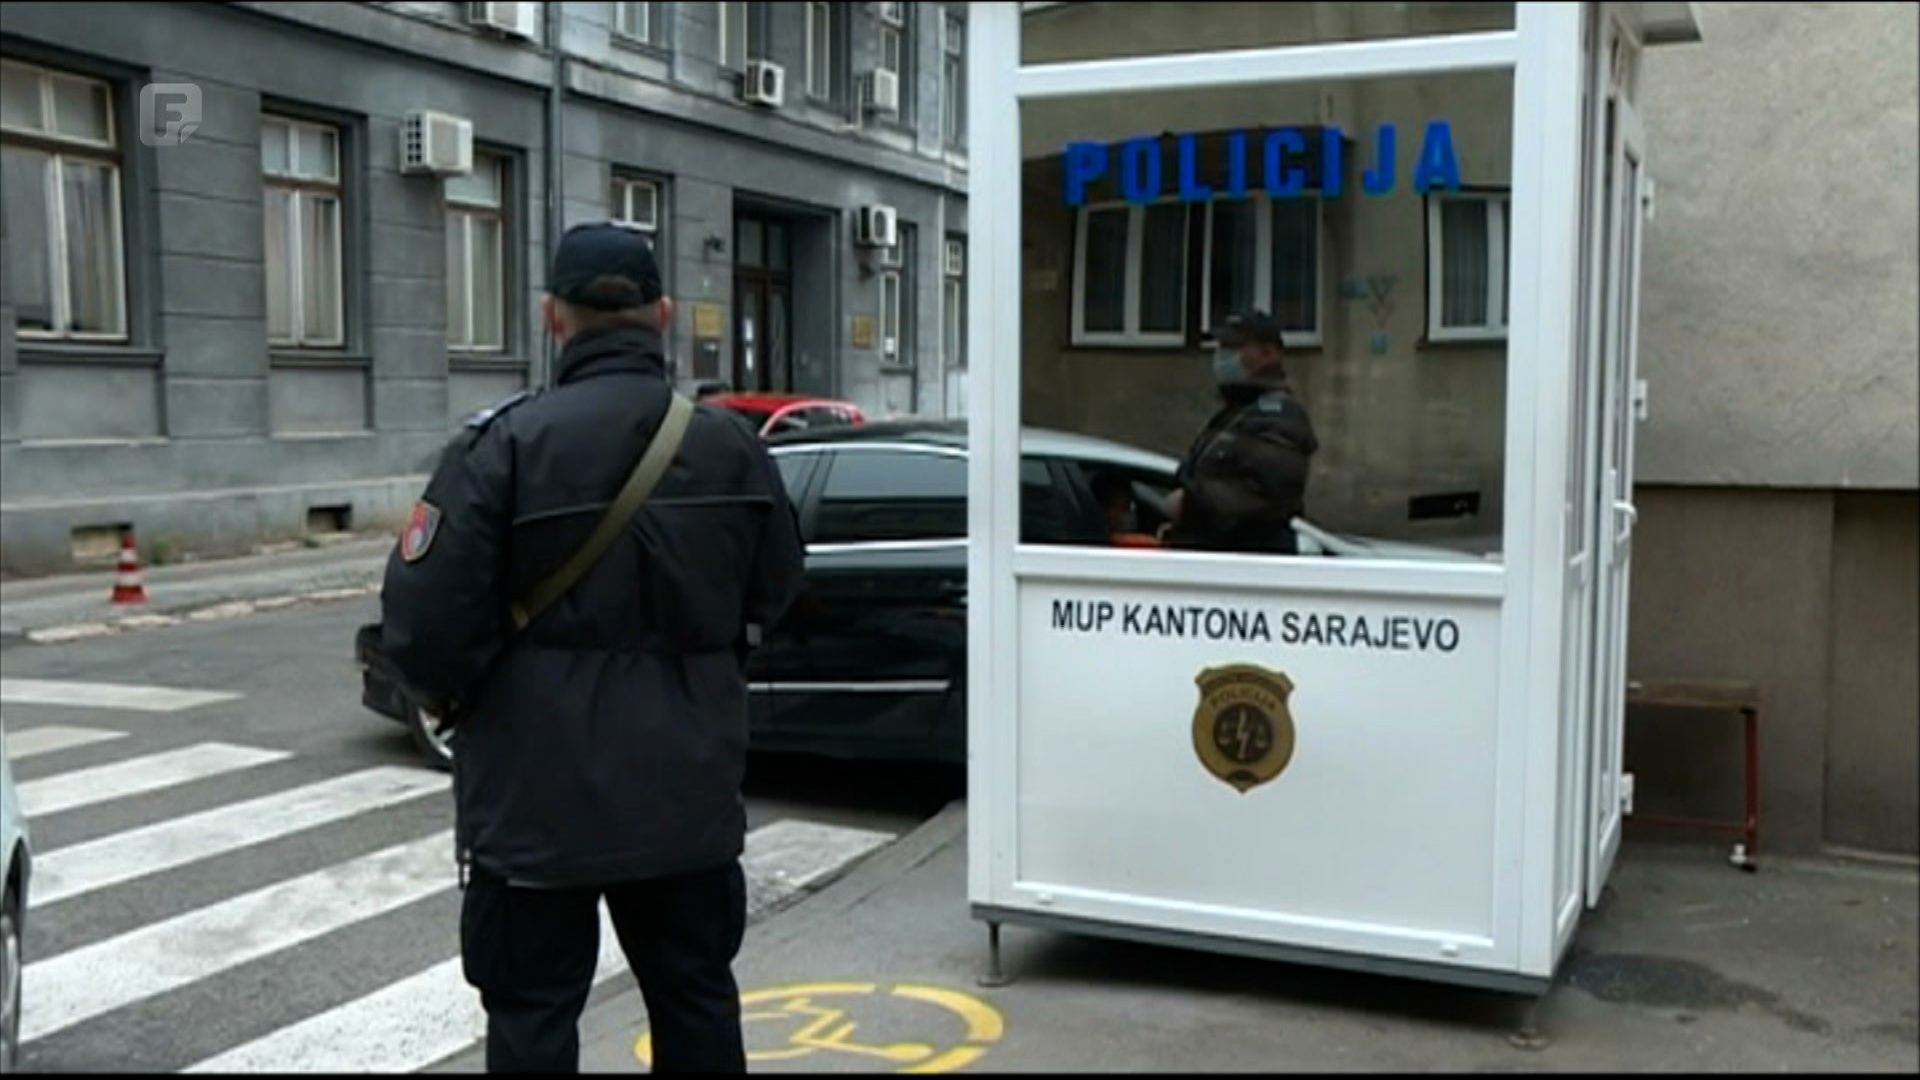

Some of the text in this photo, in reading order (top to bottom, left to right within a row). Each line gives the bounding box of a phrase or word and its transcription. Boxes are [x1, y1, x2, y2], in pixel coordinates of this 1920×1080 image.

[1062, 119, 1462, 207] POLICIJA
[1051, 599, 1461, 652] MUP KANTONA SARAJEVO
